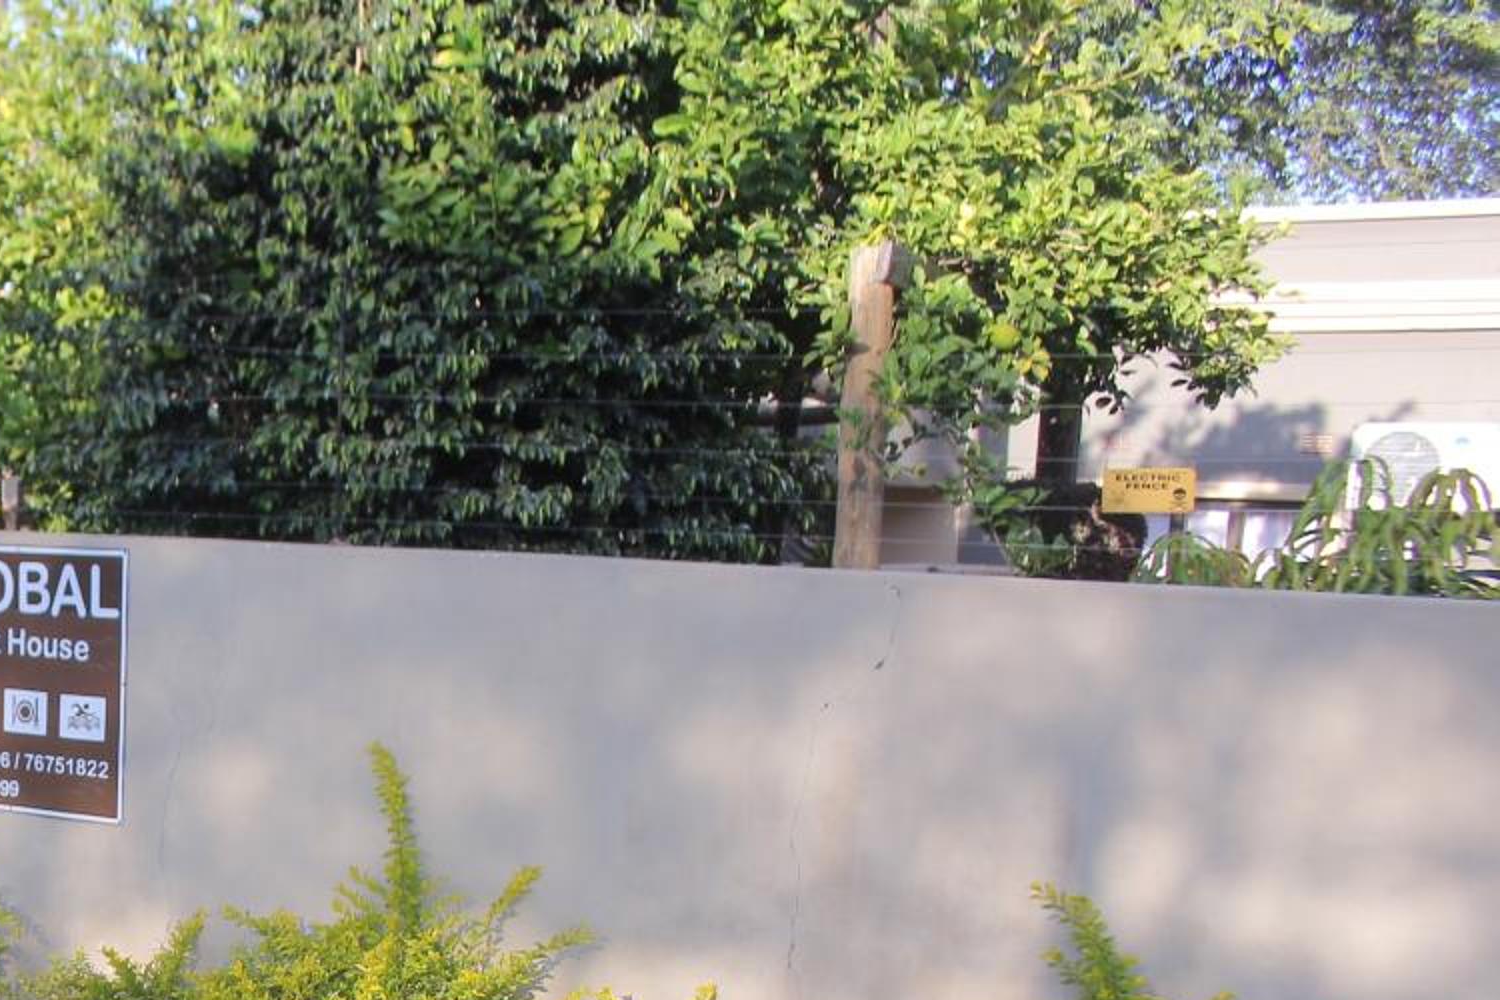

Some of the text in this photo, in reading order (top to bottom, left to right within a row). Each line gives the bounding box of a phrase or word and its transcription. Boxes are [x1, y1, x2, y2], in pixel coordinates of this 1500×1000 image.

[1115, 473, 1182, 482] ELECTRIC
[1125, 482, 1169, 491] FENCE
[7, 628, 89, 661] House
[25, 753, 109, 779] 76751822
